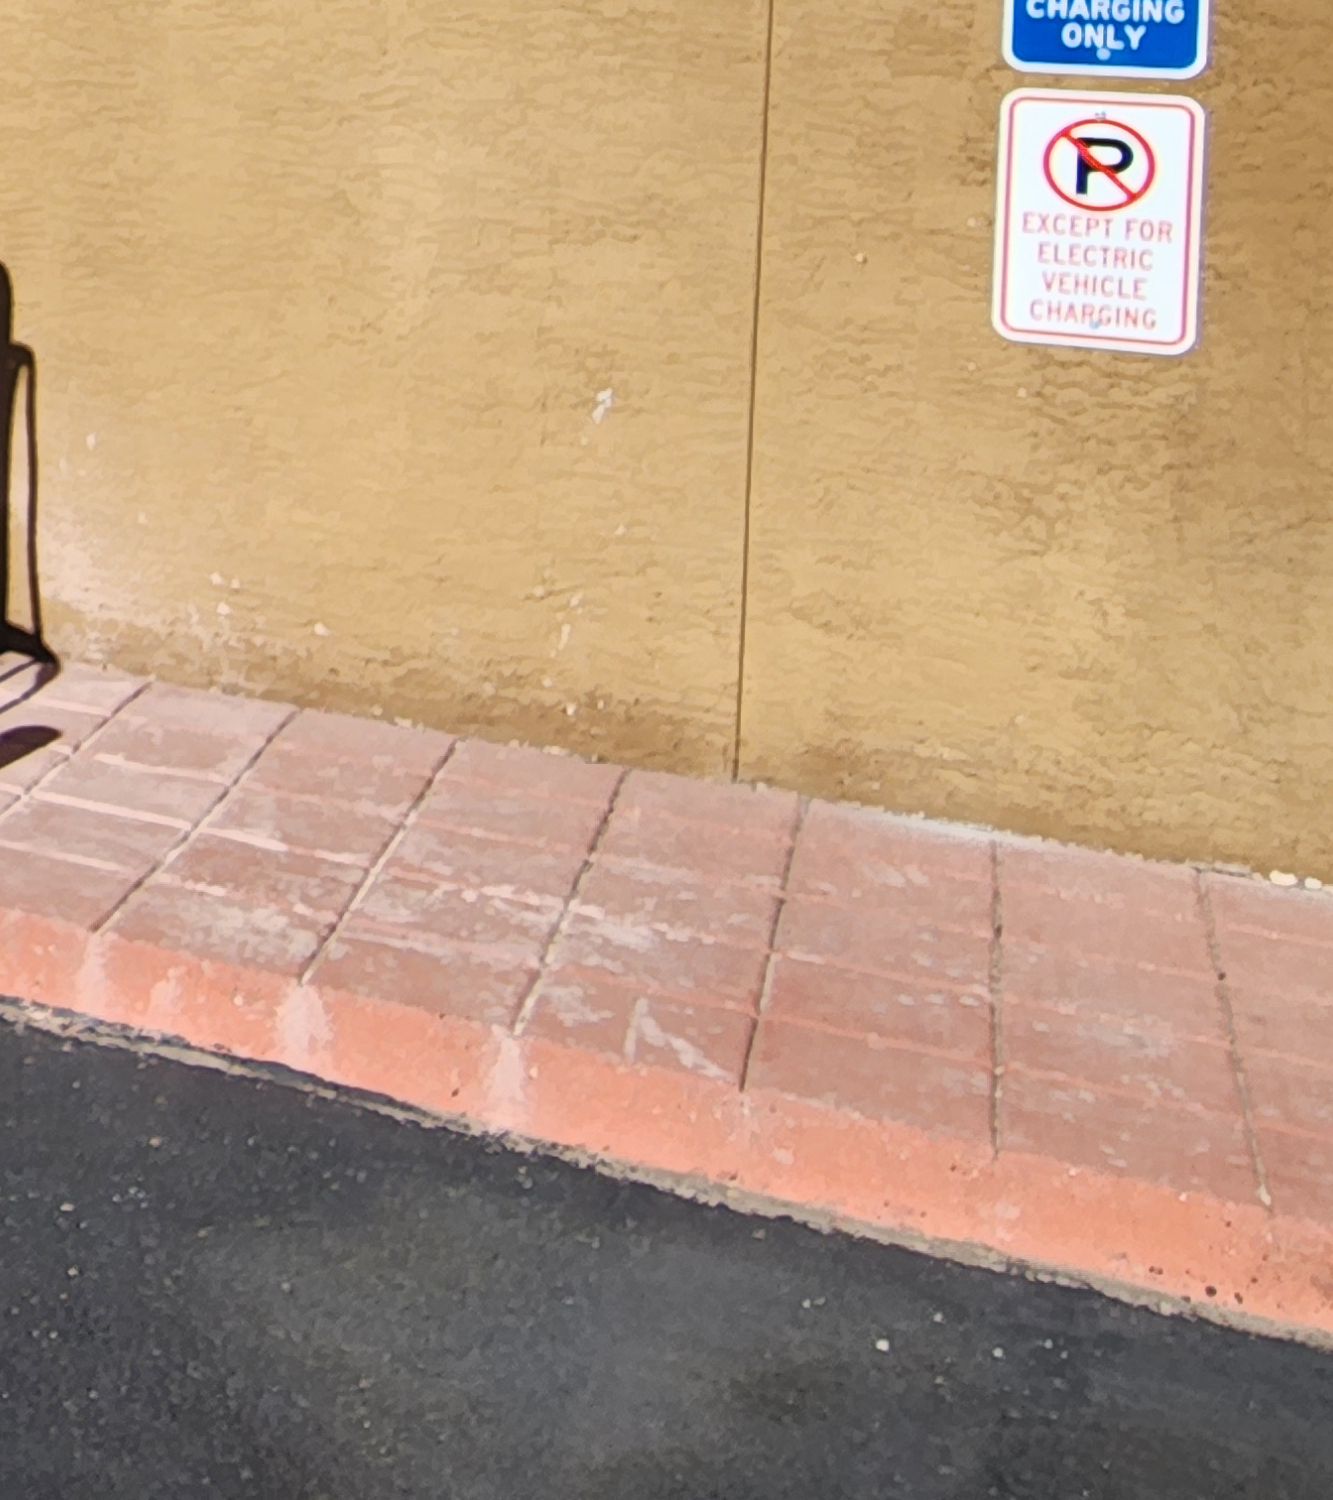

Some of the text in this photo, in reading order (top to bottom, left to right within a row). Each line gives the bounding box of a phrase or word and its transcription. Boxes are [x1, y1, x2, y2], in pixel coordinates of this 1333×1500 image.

[1061, 22, 1147, 50] ONLY
[1021, 211, 1174, 244] EXCEPT FOR
[1037, 241, 1154, 272] ELECTRIC
[1041, 271, 1148, 301] VEHICLE
[1029, 298, 1157, 331] CHARGING
